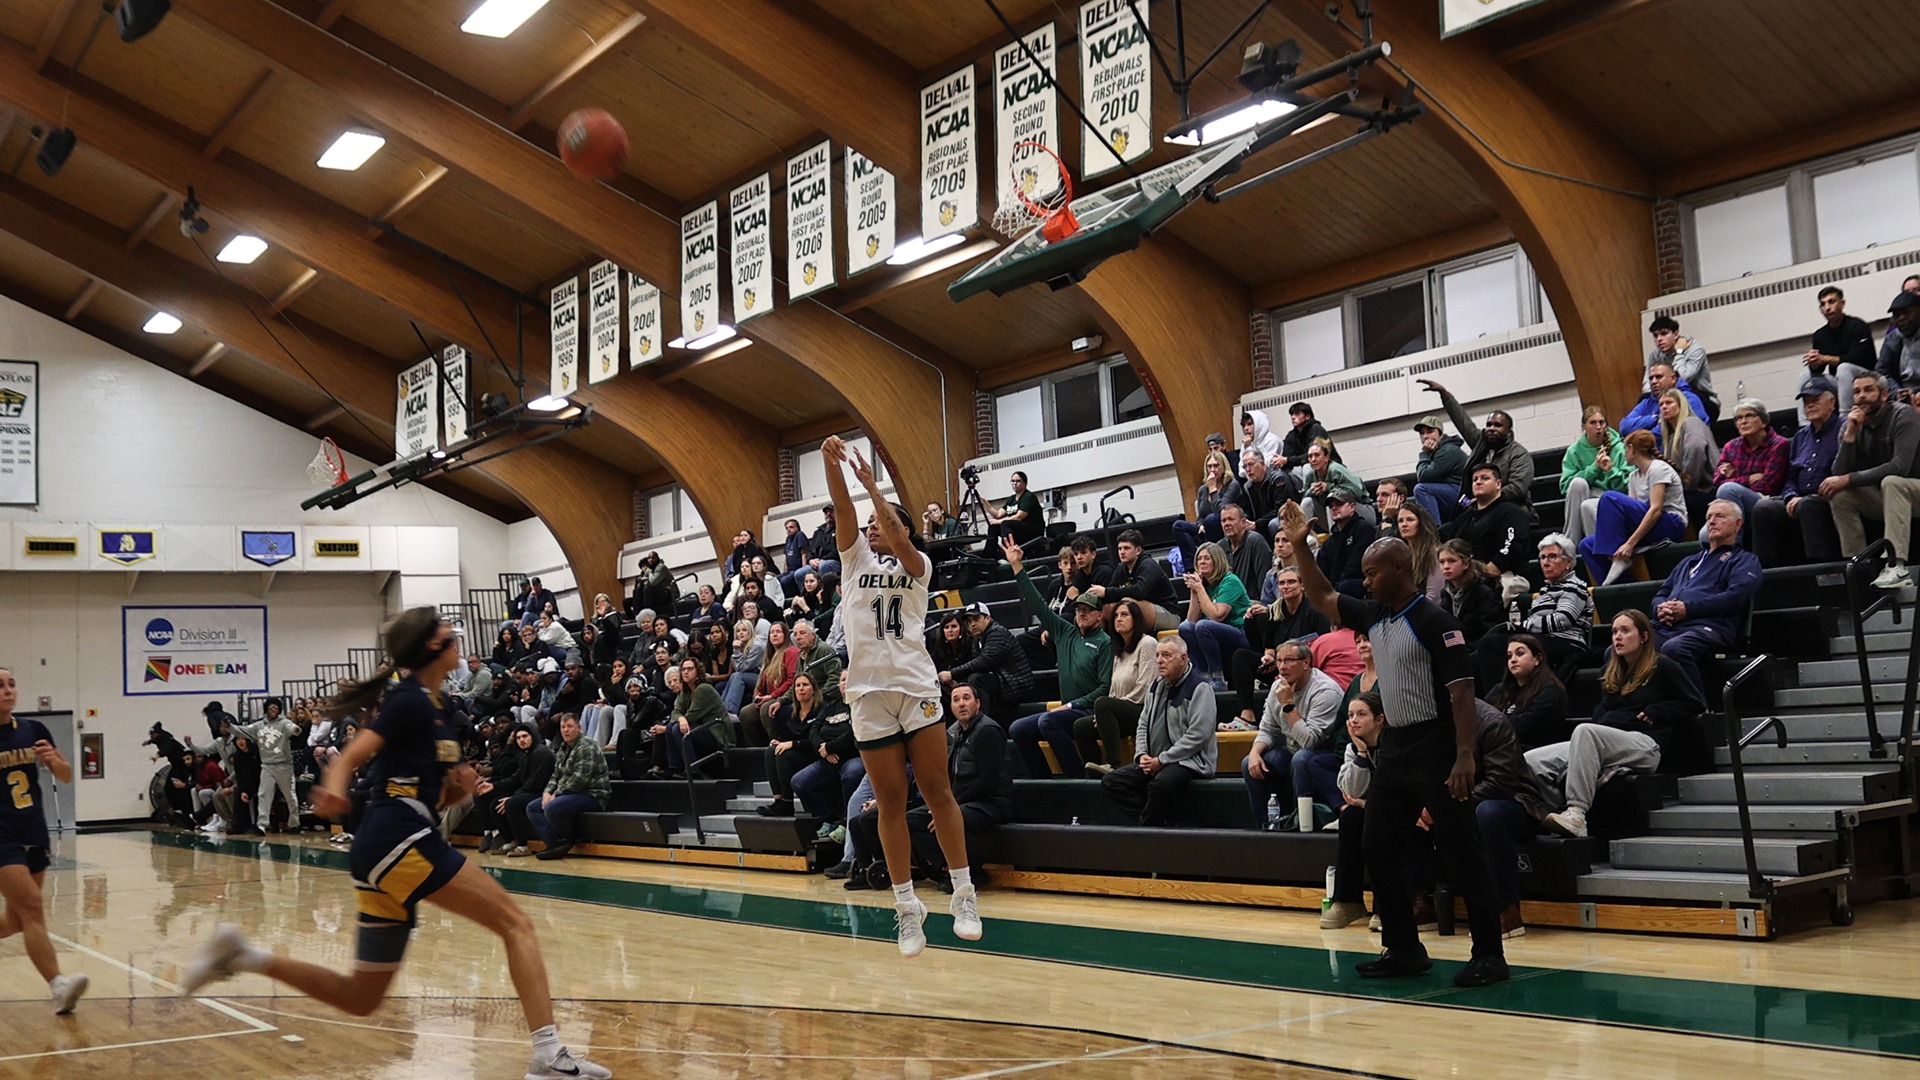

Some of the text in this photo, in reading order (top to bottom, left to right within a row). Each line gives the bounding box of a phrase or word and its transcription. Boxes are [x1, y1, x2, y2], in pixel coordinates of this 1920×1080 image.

[1089, 22, 1145, 68] NCAA
[1094, 54, 1142, 87] REGIONALS
[925, 74, 970, 110] DELVAL
[1003, 67, 1052, 110] NCAA
[1091, 69, 1146, 104] FIRST PLACE
[1012, 99, 1046, 124] SECOND
[1099, 89, 1140, 126] 2010
[926, 106, 970, 146] NCAA
[1013, 116, 1043, 138] ROUND
[928, 137, 968, 164] REGIONALS
[1012, 130, 1047, 163] 2010
[790, 148, 826, 179] DELVAL
[926, 151, 969, 179] FIRST PLACE
[733, 181, 766, 209] DELVAL
[791, 177, 826, 212] NCAA
[930, 168, 966, 200] 2009
[684, 208, 714, 234] DELVAL
[734, 207, 767, 240] NCAA
[857, 200, 887, 231] 2009
[686, 234, 715, 264] NCAA
[796, 231, 823, 260] 2008
[738, 260, 763, 285] 2007
[593, 285, 616, 312] NCAA
[689, 283, 712, 308] 2005
[553, 306, 576, 331] NCAA
[633, 309, 656, 332] 2004
[597, 328, 616, 351] 2004
[404, 391, 428, 419] NCAA
[859, 574, 913, 590] DELVAL
[870, 594, 904, 640] 14
[148, 629, 237, 640] NCAA Division III
[174, 664, 247, 676] ONETEAM
[7, 770, 34, 809] 2
